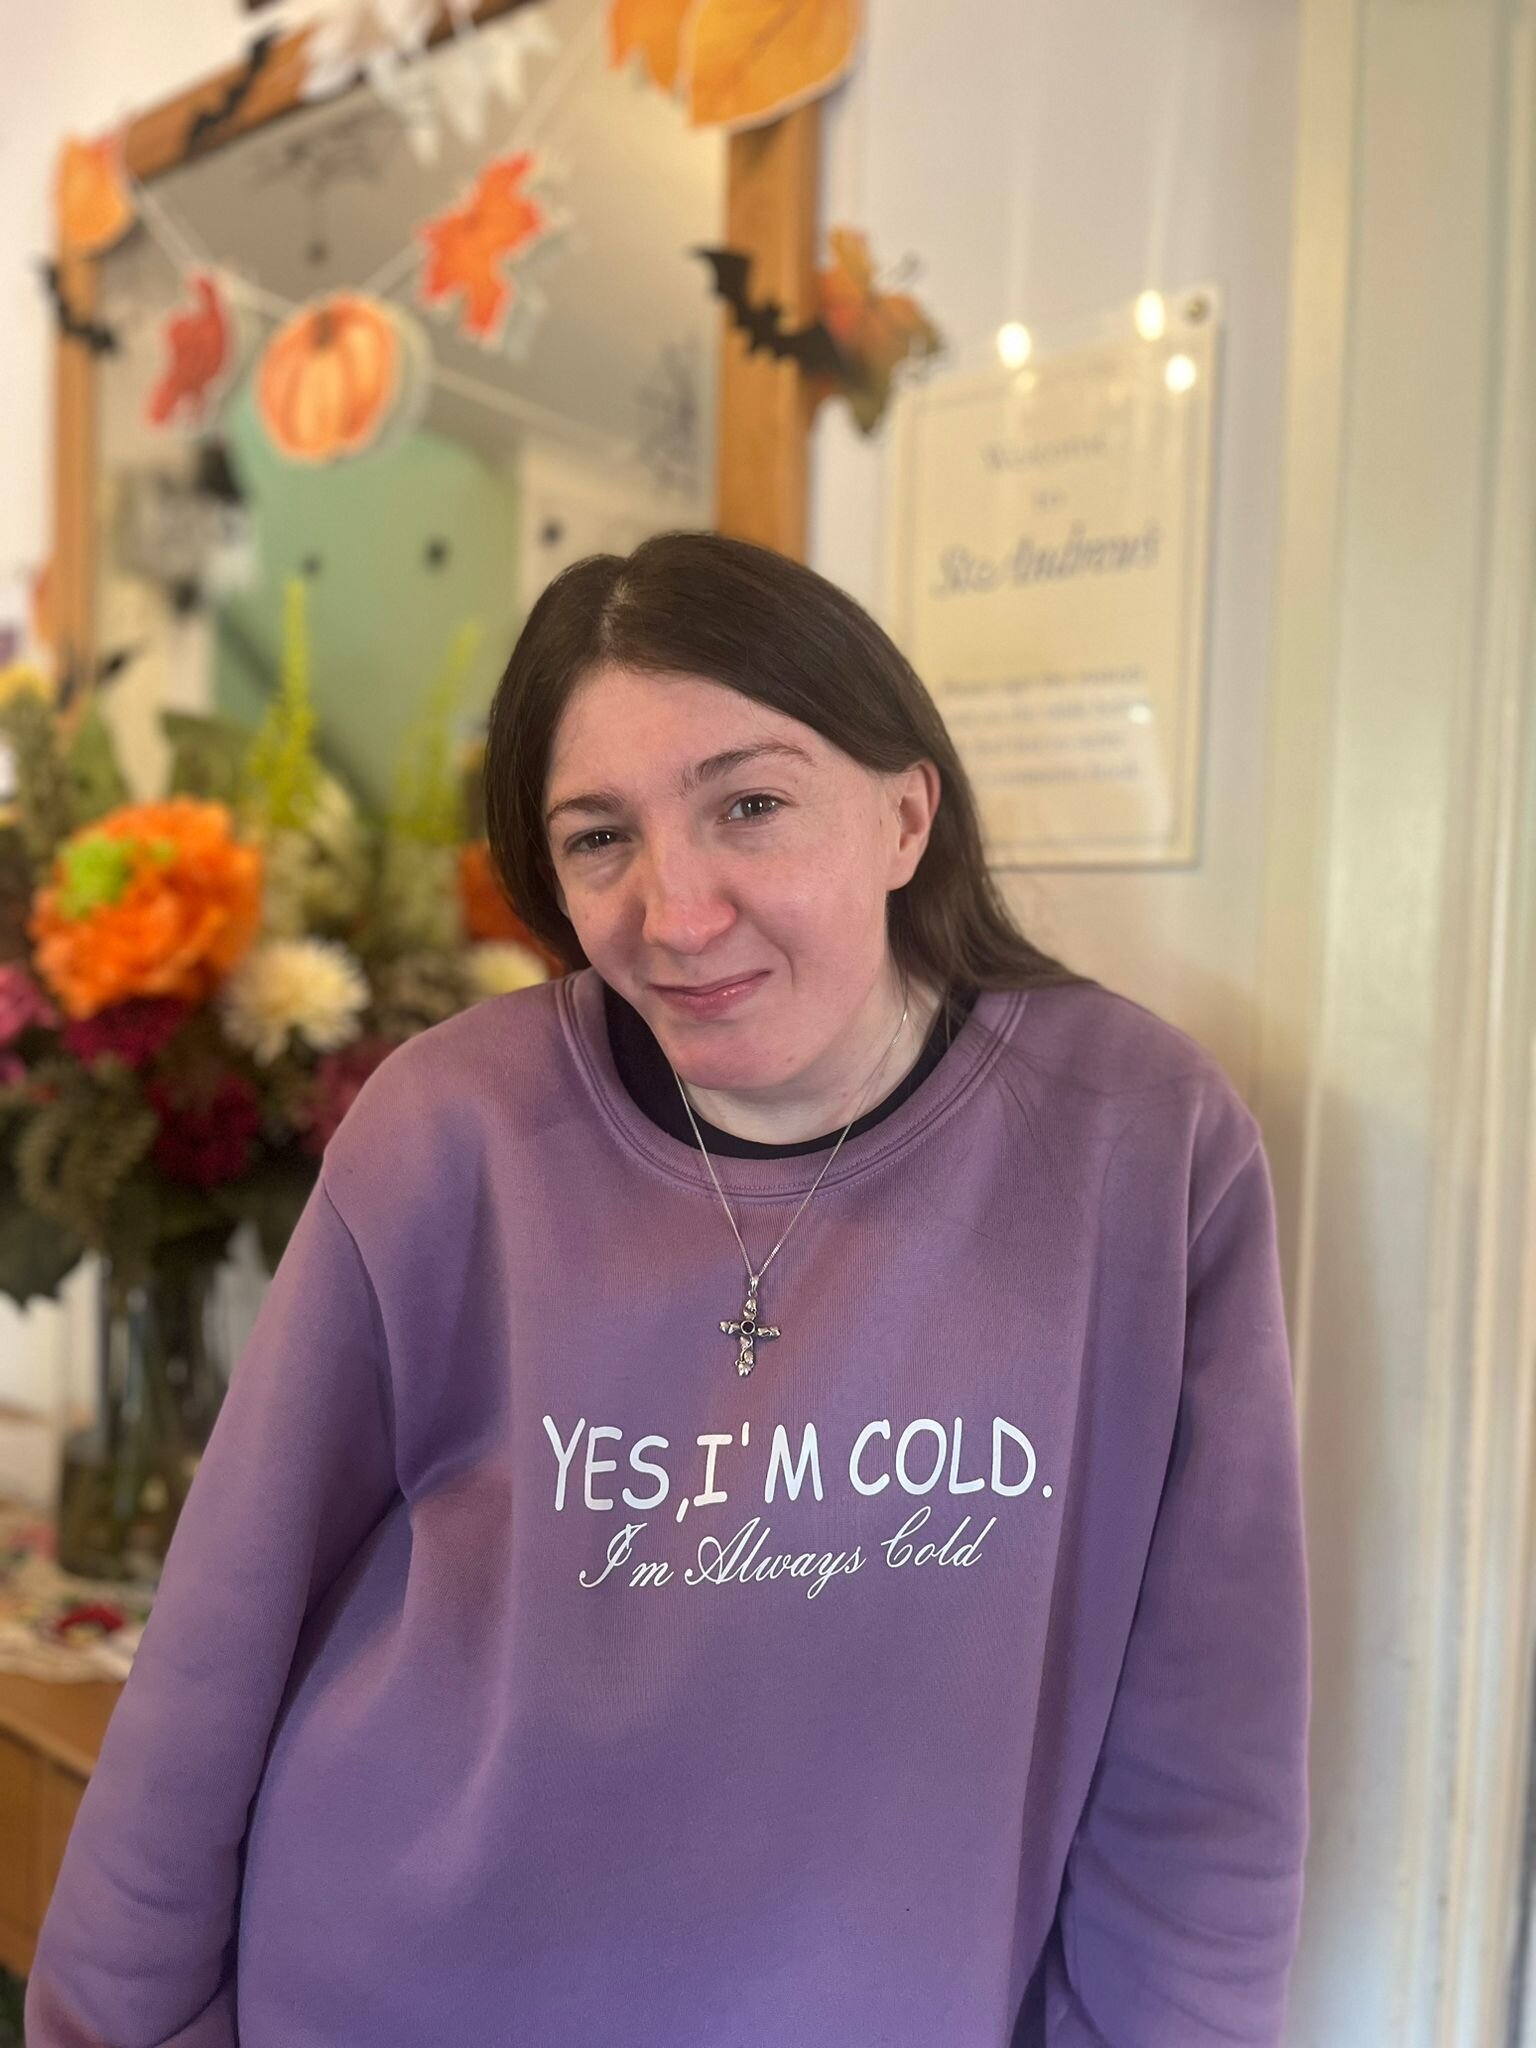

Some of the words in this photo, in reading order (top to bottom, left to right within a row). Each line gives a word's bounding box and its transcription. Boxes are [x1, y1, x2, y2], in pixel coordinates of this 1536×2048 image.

[849, 1416, 1053, 1498] COLD.
[684, 1516, 867, 1600] Always
[880, 1505, 997, 1568] Cold
